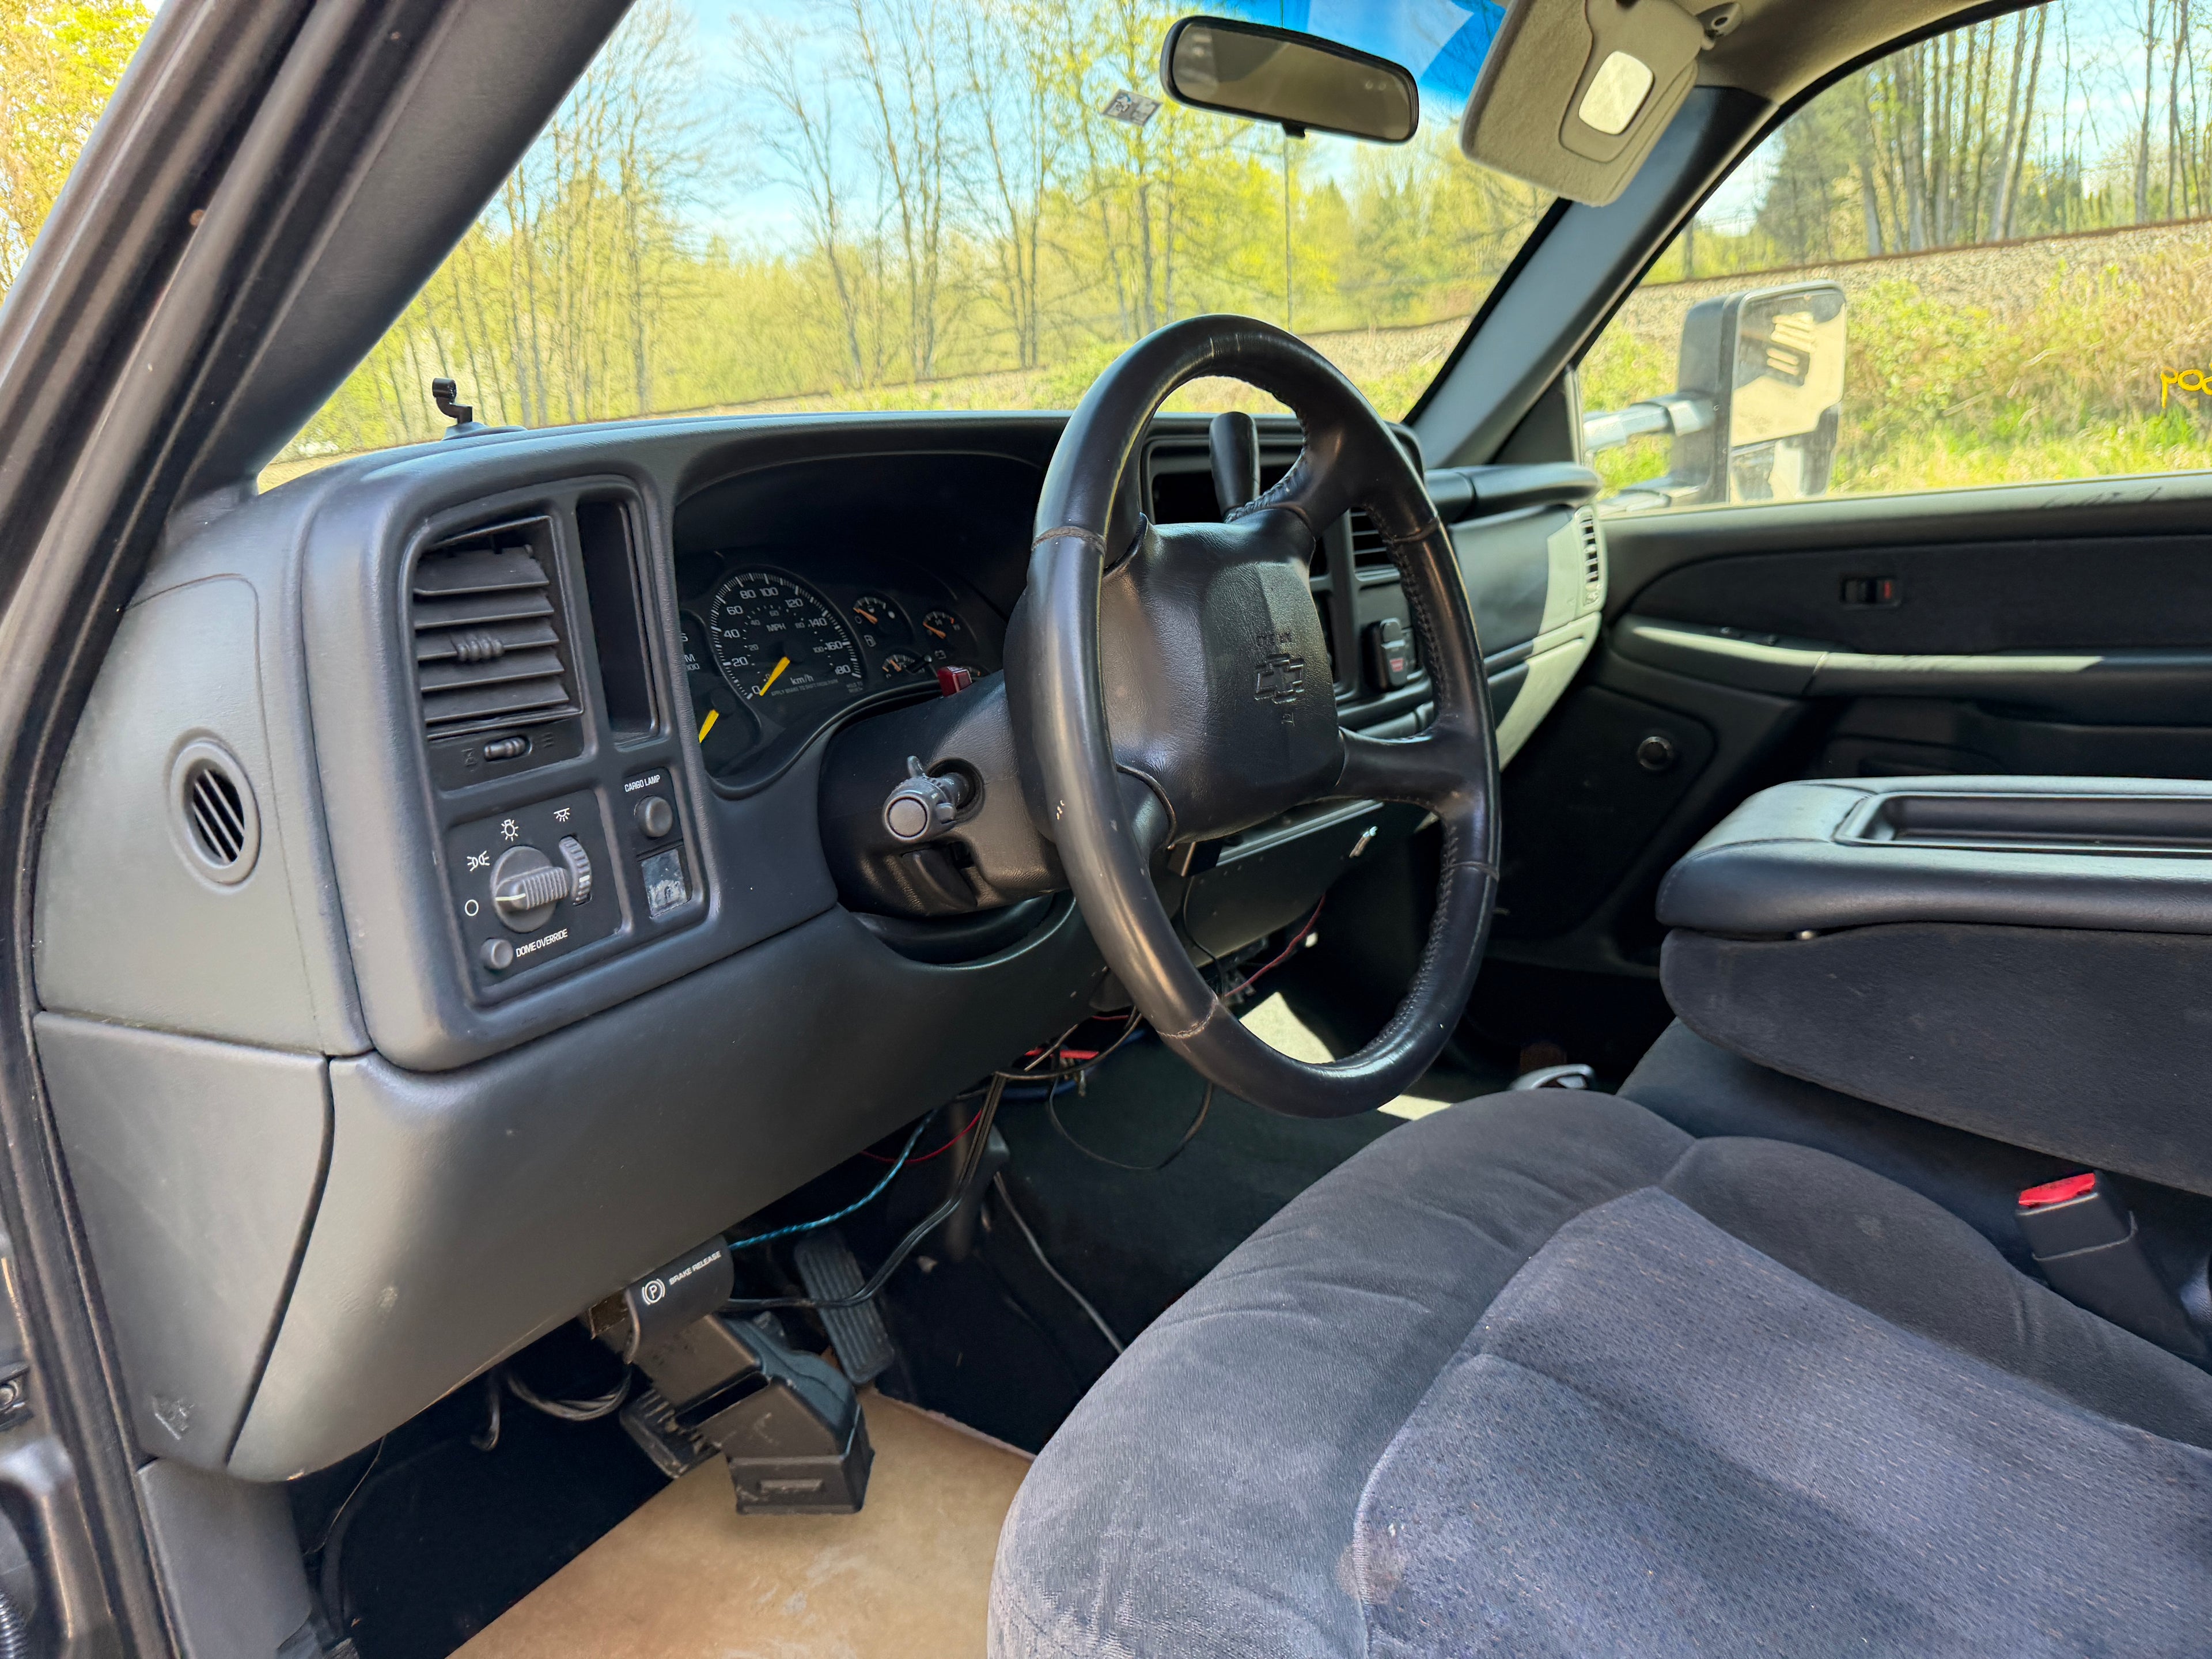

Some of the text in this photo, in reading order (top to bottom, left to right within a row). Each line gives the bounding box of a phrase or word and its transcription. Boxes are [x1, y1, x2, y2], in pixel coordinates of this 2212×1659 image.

[740, 589, 757, 599] 80
[759, 587, 778, 597] 100
[785, 599, 803, 608] 120
[726, 605, 743, 615] 60
[808, 618, 828, 627] 140
[766, 623, 786, 632] MPH
[724, 629, 740, 638] 40
[825, 641, 843, 650] 160
[731, 657, 748, 666] 20
[790, 674, 814, 685] km/h
[751, 685, 760, 694] 0
[624, 774, 660, 792] CARGO LAMP
[516, 928, 568, 957] DOME OVERRIDE
[669, 1251, 721, 1285] BRAKE RELEASE
